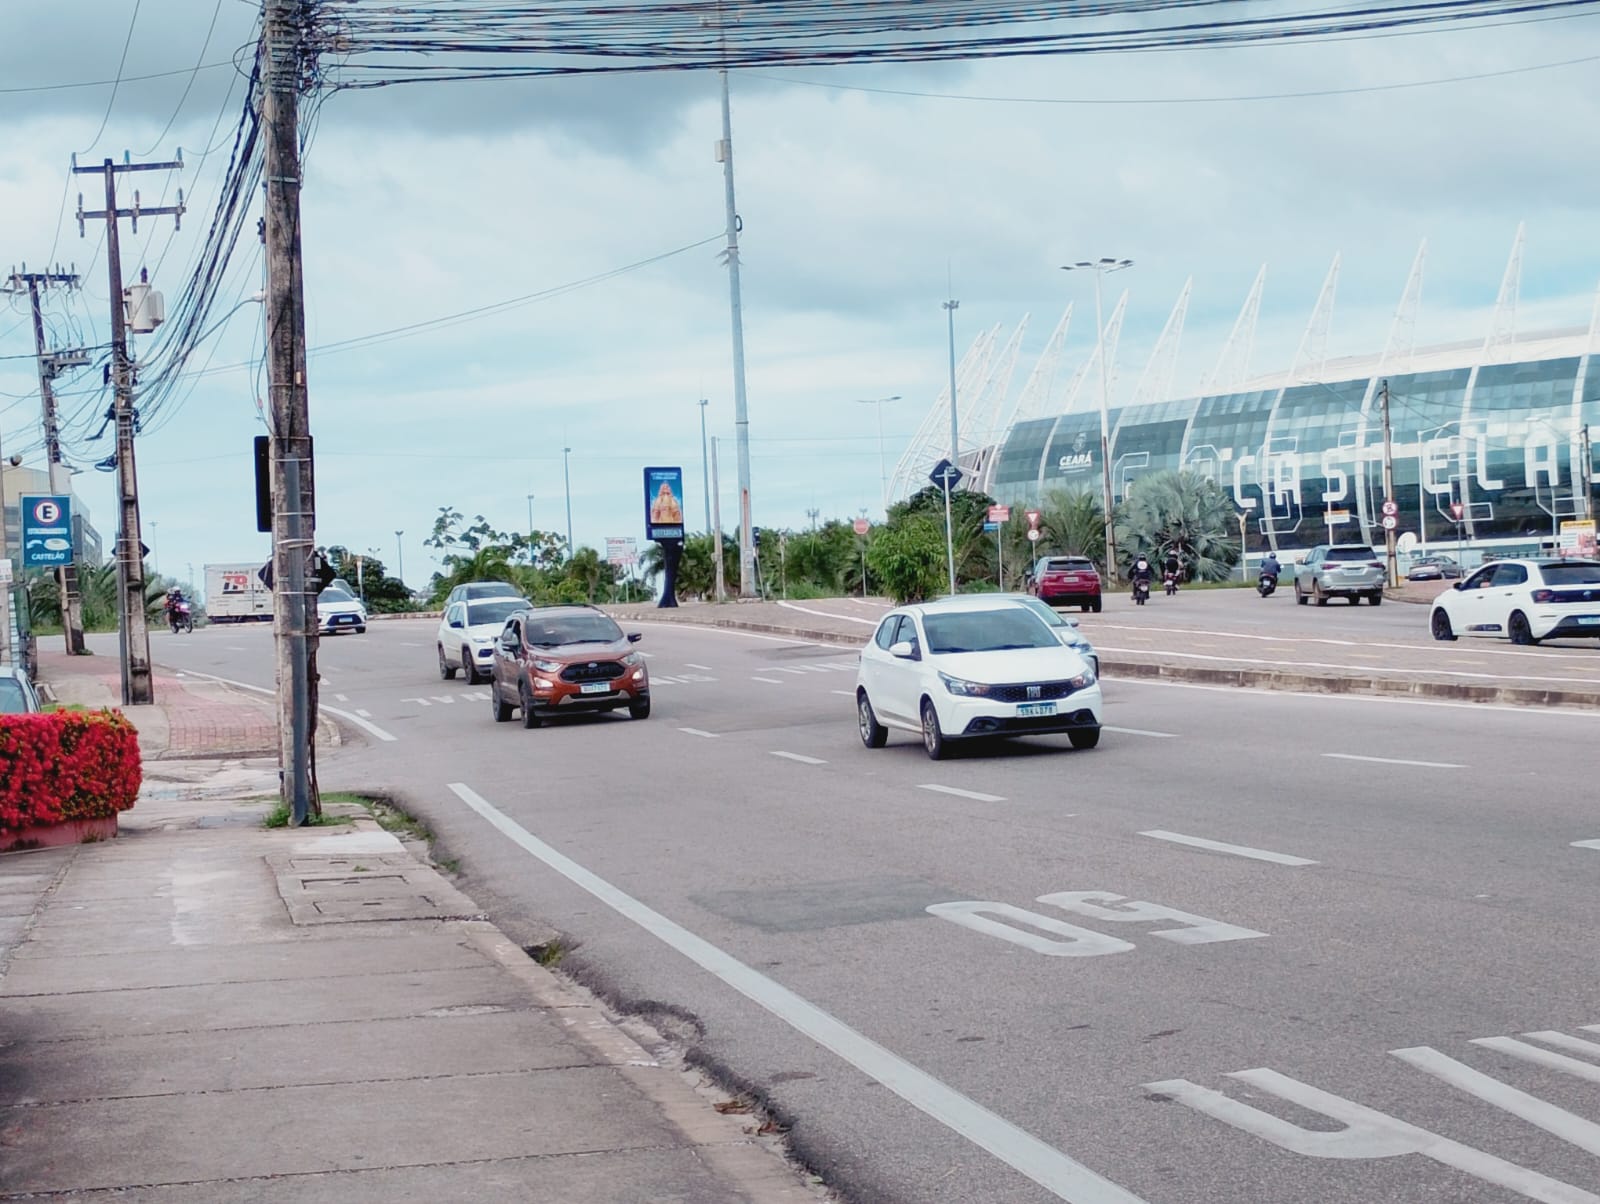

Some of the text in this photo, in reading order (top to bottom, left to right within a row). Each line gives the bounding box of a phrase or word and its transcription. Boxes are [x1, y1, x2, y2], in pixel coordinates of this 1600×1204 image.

[1059, 450, 1092, 466] CEARÁ
[42, 505, 52, 520] E
[31, 551, 65, 561] CASTELÃO
[924, 890, 1270, 957] 50
